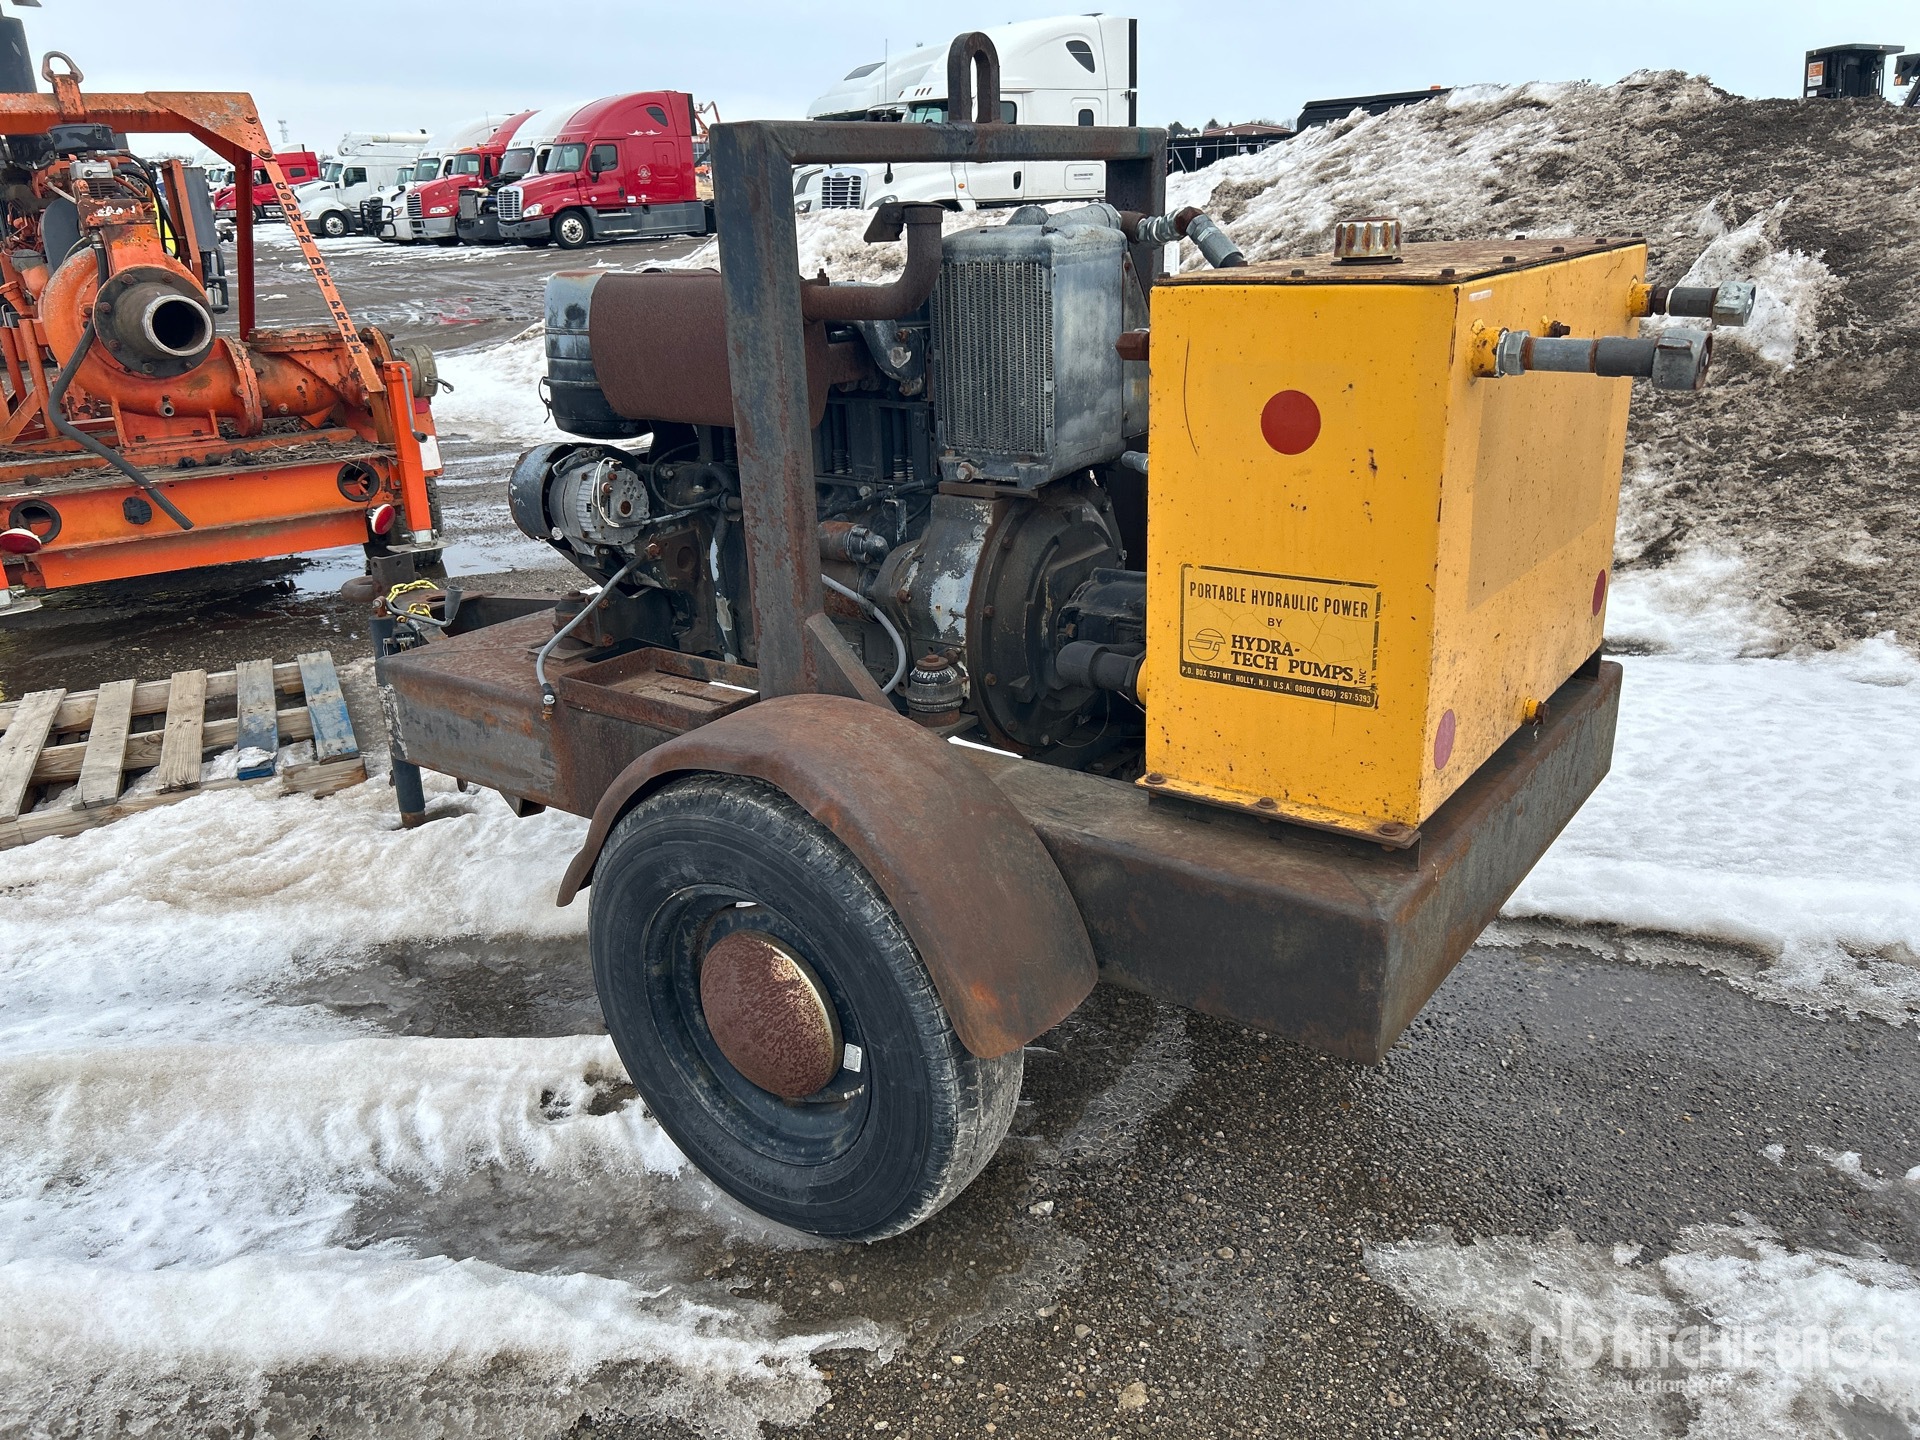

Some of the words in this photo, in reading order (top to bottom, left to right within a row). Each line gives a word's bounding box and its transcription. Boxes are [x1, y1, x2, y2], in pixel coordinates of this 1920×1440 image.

[309, 256, 330, 287] DRI
[329, 300, 362, 354] PRIME
[1189, 581, 1247, 604] PORTABLE
[1251, 589, 1319, 613] HYDRAULIC
[1323, 597, 1369, 619] POWER
[1267, 617, 1283, 628] BY
[1231, 634, 1301, 657] HYDRA-
[1181, 666, 1194, 675] P.O.
[1195, 668, 1207, 677] BOX
[1209, 670, 1220, 679] 537
[1222, 672, 1234, 682] MT.
[1235, 674, 1256, 686] HOLLY,
[1258, 678, 1271, 688] N.J.
[1273, 680, 1293, 691] U.S.A.
[1294, 684, 1315, 695] 08060
[1316, 687, 1337, 699] (609)
[1339, 691, 1371, 704] 267-5393
[1230, 651, 1279, 671] TECH
[1358, 668, 1367, 685] INC
